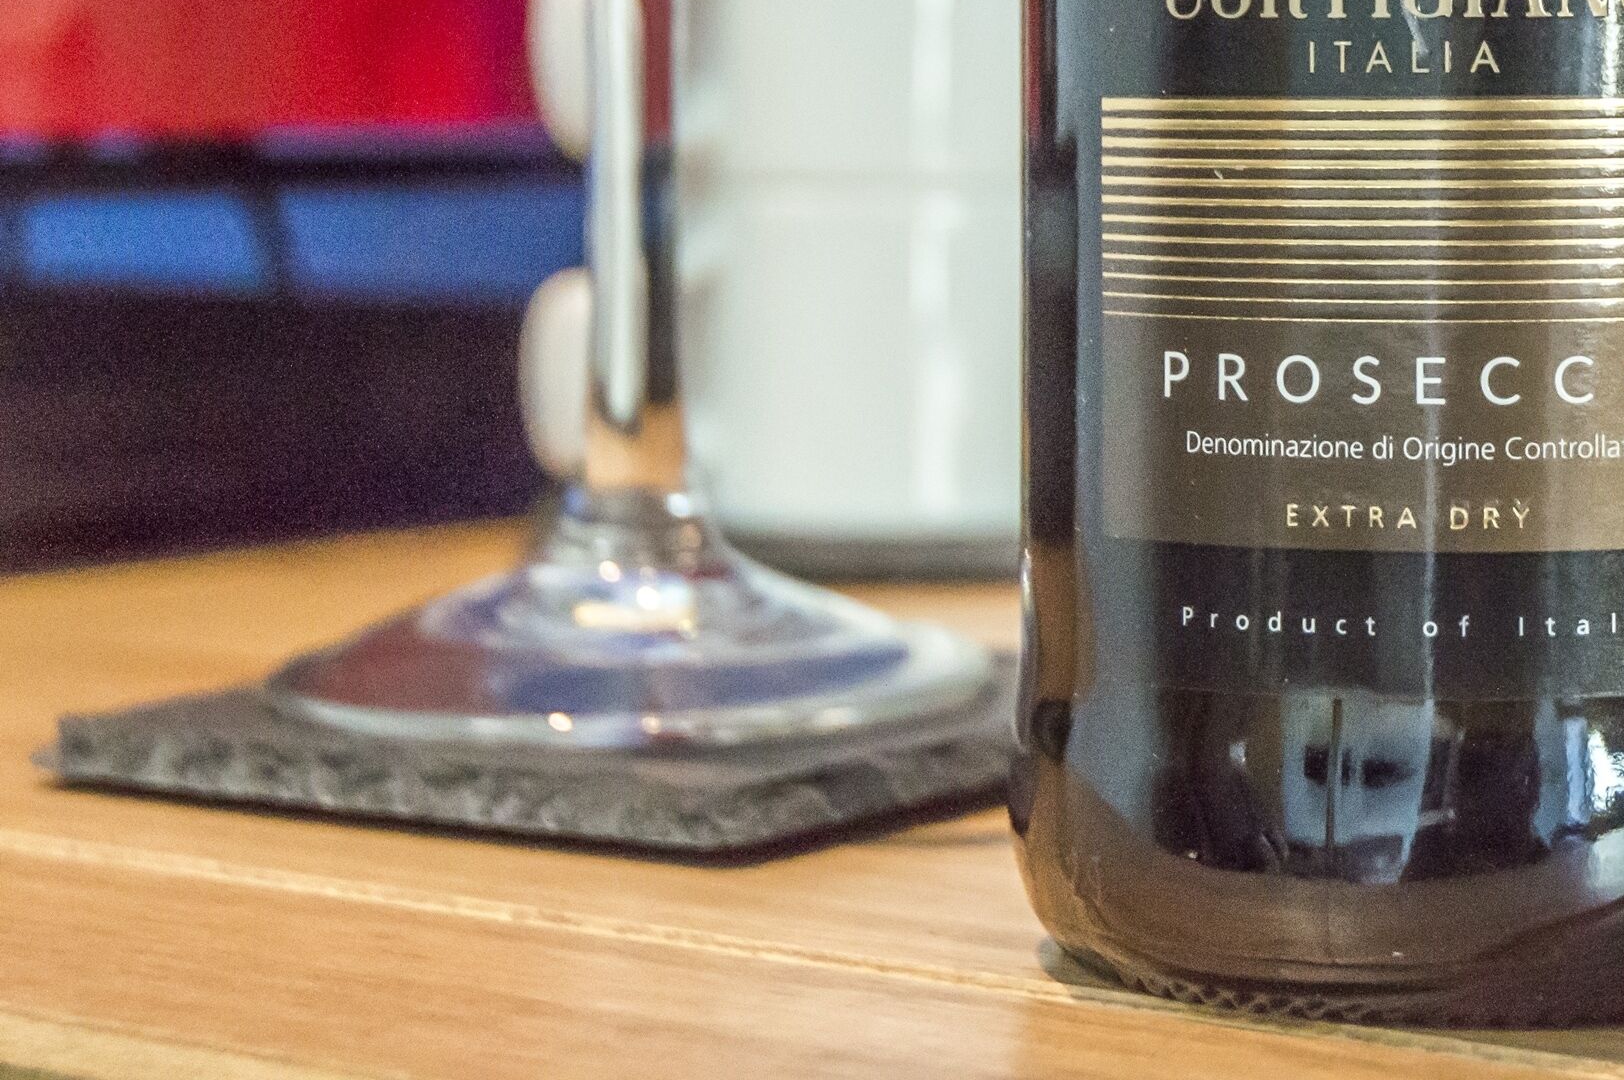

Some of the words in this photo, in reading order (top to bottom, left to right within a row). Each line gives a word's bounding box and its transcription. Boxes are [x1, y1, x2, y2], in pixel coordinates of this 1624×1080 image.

[1308, 40, 1501, 74] ITALIA
[1185, 431, 1364, 461] Denominazione
[1371, 435, 1394, 460] di
[1402, 435, 1496, 467] Origine
[1285, 504, 1418, 530] EXTRA
[1449, 505, 1532, 531] DRY
[1182, 606, 1376, 638] Product
[1422, 615, 1470, 639] of
